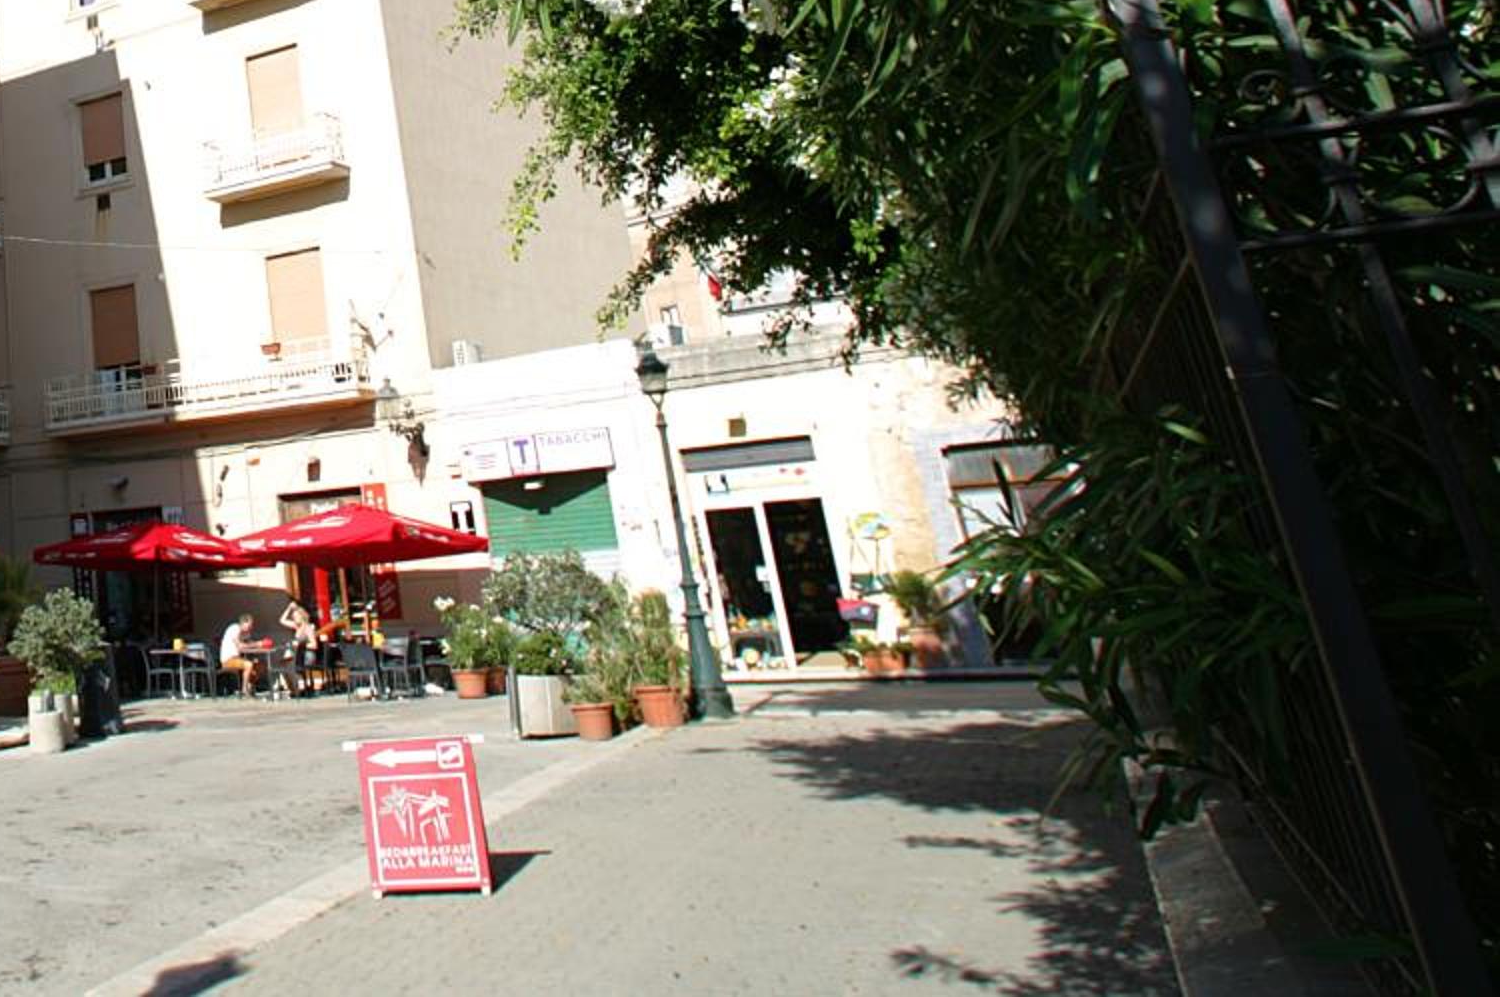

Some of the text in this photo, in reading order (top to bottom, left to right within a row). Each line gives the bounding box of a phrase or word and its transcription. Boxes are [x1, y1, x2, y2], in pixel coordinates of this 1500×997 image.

[513, 439, 529, 464] T
[383, 855, 474, 870] ALLA MARINA
